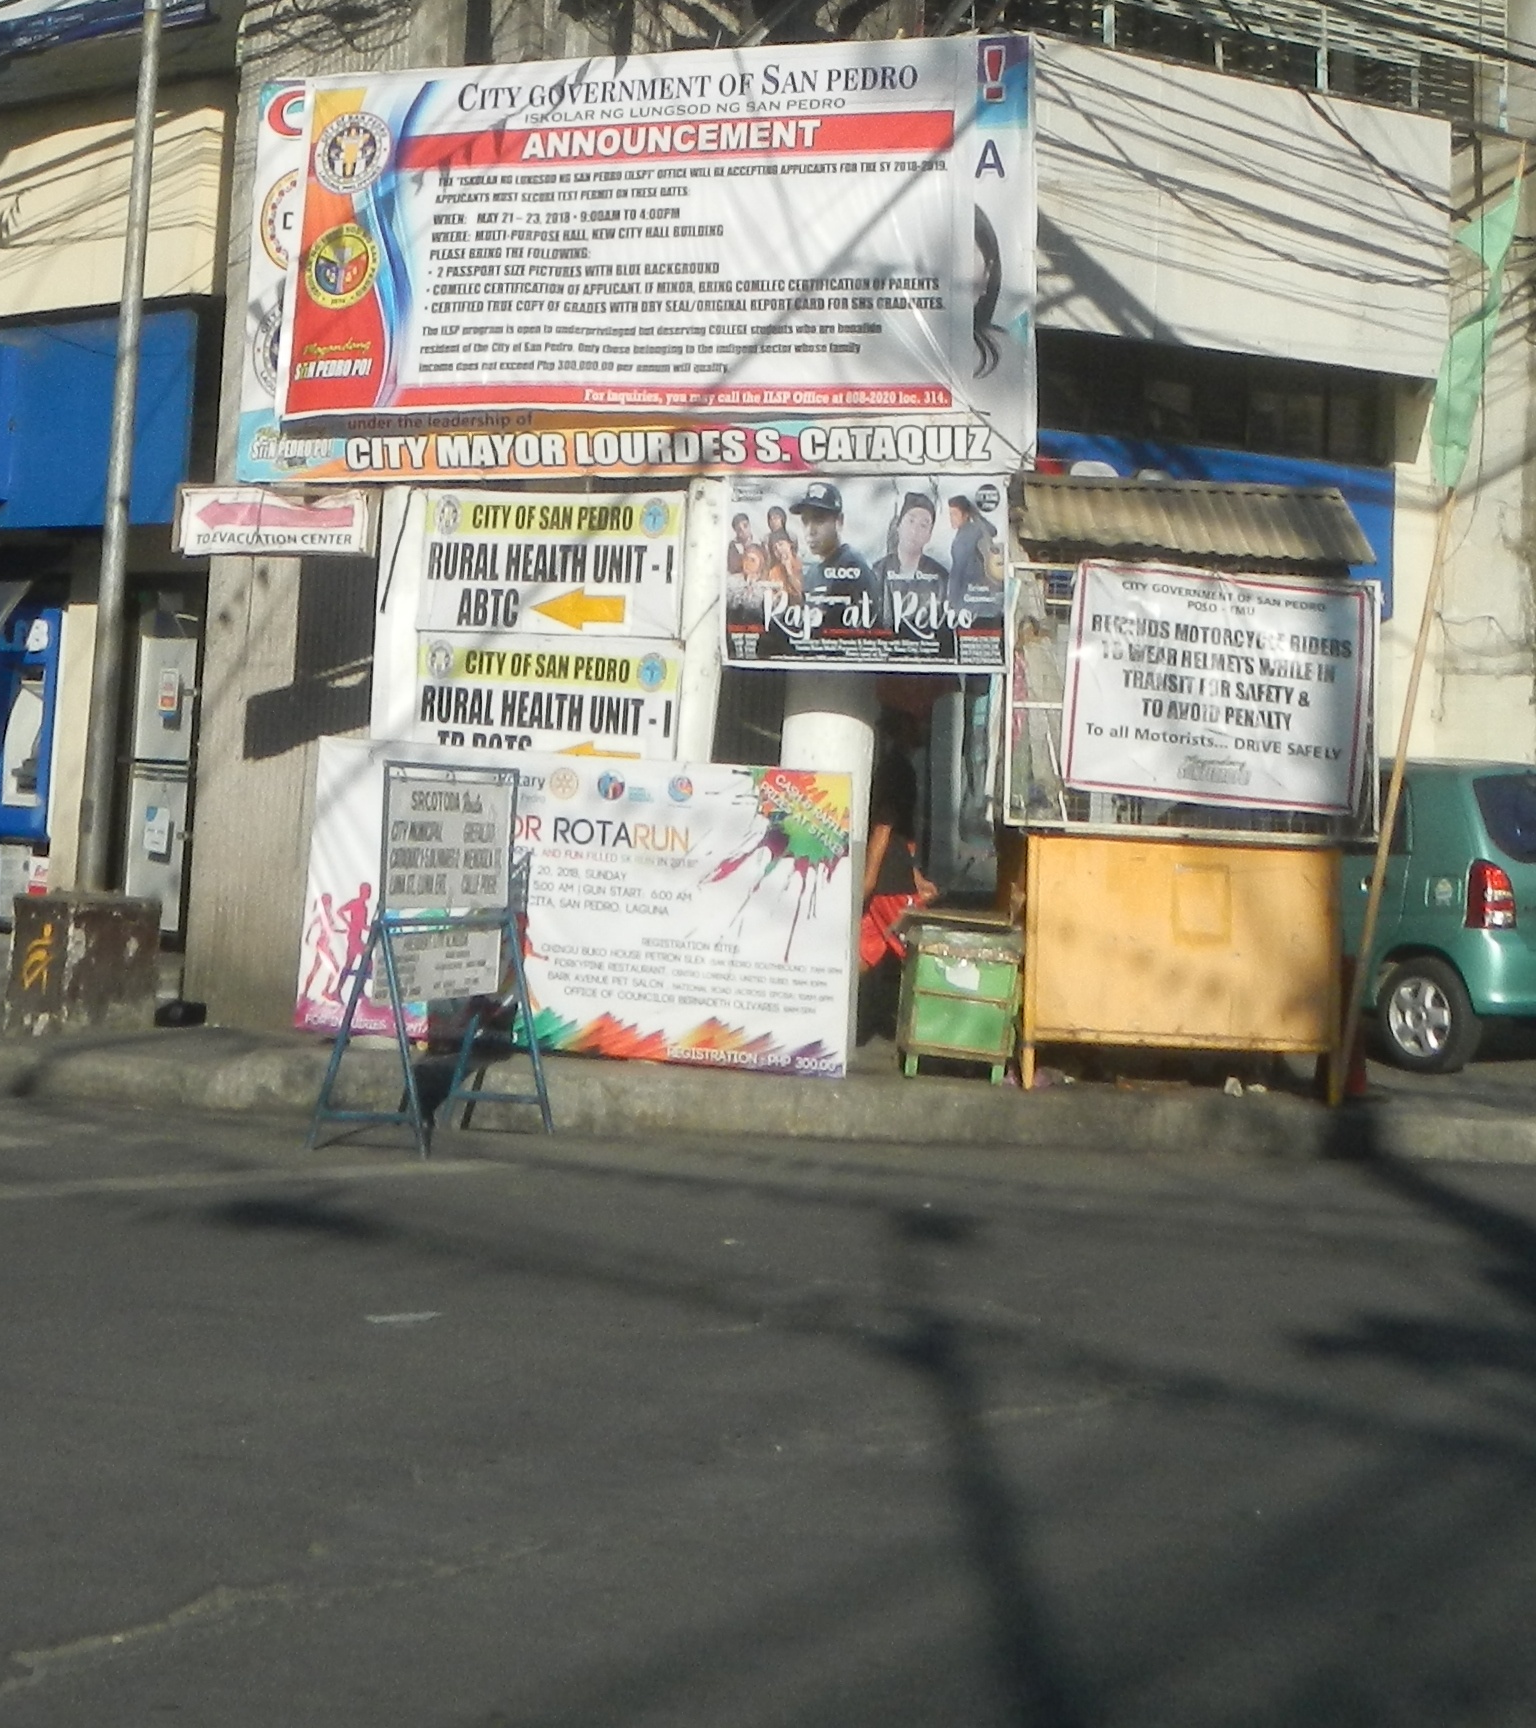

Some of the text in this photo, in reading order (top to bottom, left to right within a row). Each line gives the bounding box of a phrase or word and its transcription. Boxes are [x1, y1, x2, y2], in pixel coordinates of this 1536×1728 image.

[524, 97, 847, 125] ISKOLAR NG LUNGSOD NG SAN PEDRO
[520, 119, 823, 161] ANNOUNCEMENT
[429, 248, 466, 261] PLEASE
[467, 247, 503, 260] BRING
[504, 247, 525, 259] THE
[445, 264, 502, 278] PASSPORT
[503, 264, 526, 277] SIZE
[527, 264, 583, 278] PICTURES
[584, 264, 613, 277] WITH
[615, 263, 642, 276] BLUE
[643, 261, 720, 275] BACKGROUND
[583, 389, 606, 401] For
[665, 392, 687, 406] you
[716, 390, 741, 403] call
[741, 390, 762, 403] the
[763, 390, 791, 403] ILSP
[792, 389, 830, 404] Office
[831, 390, 845, 403] at
[898, 389, 922, 403] loc.
[347, 412, 534, 432] under the leadership of
[344, 424, 993, 472] CITY MAYOR LOURDES S. CATAQUIZ
[471, 504, 634, 532] CITY OF SAN PEDRO
[196, 531, 353, 545] TO EVACUATION CENTER
[427, 541, 648, 584] RURAL HEALTH UNIT
[823, 566, 862, 580] GLOC9
[456, 587, 520, 628] ABTC
[1121, 580, 1327, 613] CITY GOVERNMENT OF SAN PEDRO
[764, 589, 825, 641] Rap
[841, 589, 879, 630] at
[891, 589, 980, 640] Retro
[1289, 634, 1354, 659] RIDERS
[465, 649, 631, 684] CITY OF SAN PEDRO
[1127, 642, 1178, 667] WEAR
[1180, 647, 1256, 677] HELMETS
[1258, 656, 1314, 682] WHILE
[1316, 664, 1336, 684] IN
[1122, 668, 1196, 696] TRANSIT
[1234, 681, 1295, 706] SAFETY
[1297, 690, 1311, 708] &
[420, 684, 644, 737] RURAL HEALTH UNIT
[1141, 697, 1164, 718] TO
[1224, 705, 1293, 732] PENALTY
[1085, 722, 1343, 761] To all Motorists... DRIVE SAFELY
[552, 815, 691, 854] ROTARUN
[585, 868, 627, 882] SUNDAY
[558, 882, 575, 893] AM
[582, 882, 607, 897] GUN
[675, 890, 693, 902] AM
[560, 897, 580, 910] SAN
[625, 902, 670, 917] LAGUNA
[610, 947, 642, 962] HOUSE
[644, 950, 681, 966] PETRON
[684, 953, 706, 966] SLEX
[641, 936, 711, 953] REGISTRATION
[607, 960, 667, 977] RESTAURANT
[573, 972, 609, 986] AVENUE
[611, 976, 629, 989] PET
[632, 976, 664, 991] SALON
[563, 985, 598, 999] OFFICE
[600, 988, 616, 1000] OF
[617, 989, 676, 1005] COUNCILOR
[678, 993, 732, 1010] BERNADETH
[666, 1046, 758, 1067] REGISTRATION
[767, 1054, 792, 1068] PHP
